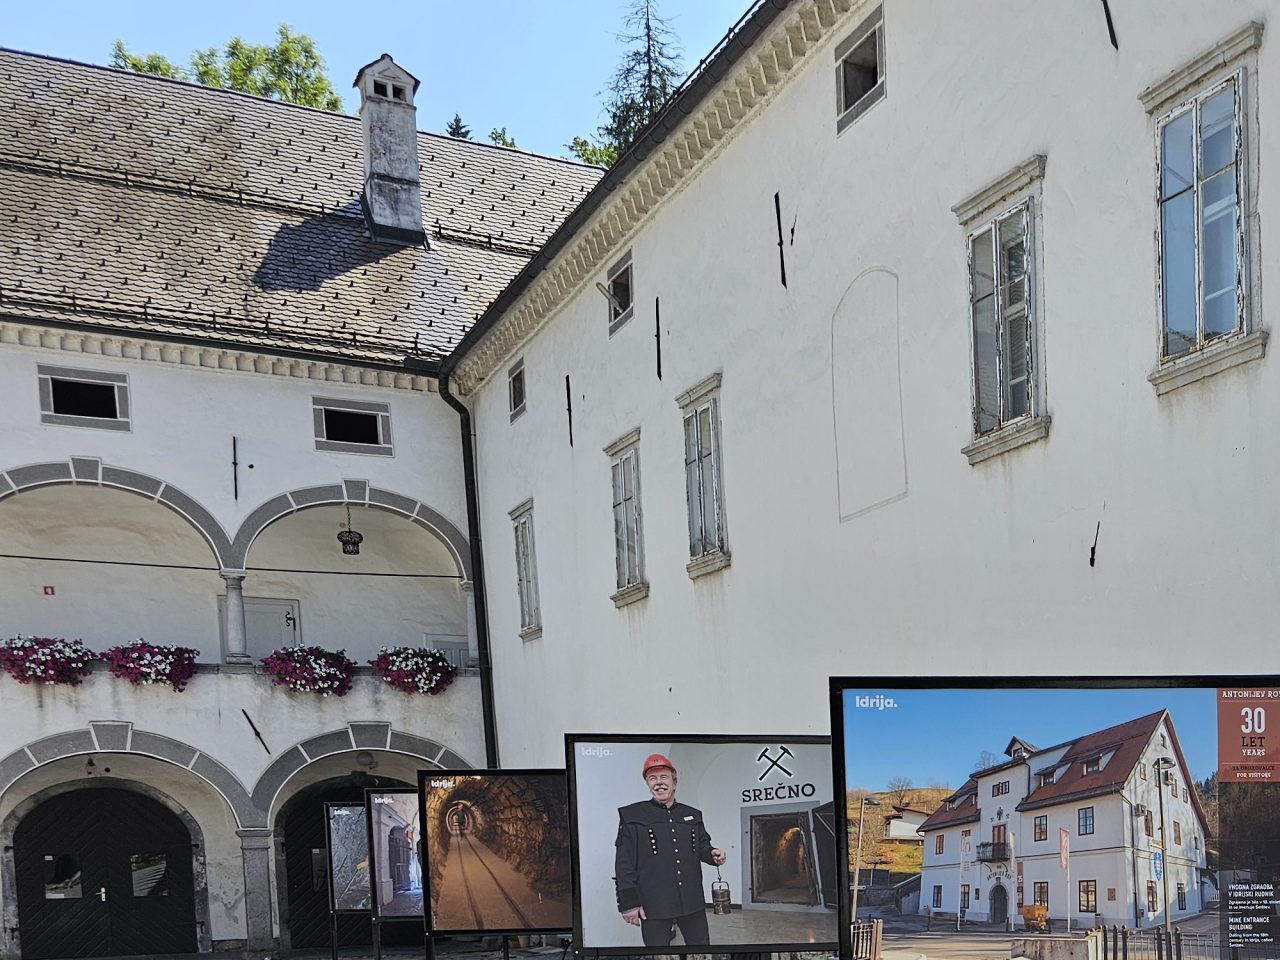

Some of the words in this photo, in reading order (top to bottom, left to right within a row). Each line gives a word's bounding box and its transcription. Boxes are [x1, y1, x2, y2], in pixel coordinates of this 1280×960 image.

[856, 696, 898, 710] Idrija.
[1240, 707, 1266, 734] 30
[1242, 736, 1266, 747] LET
[742, 782, 816, 802] SREČNO
